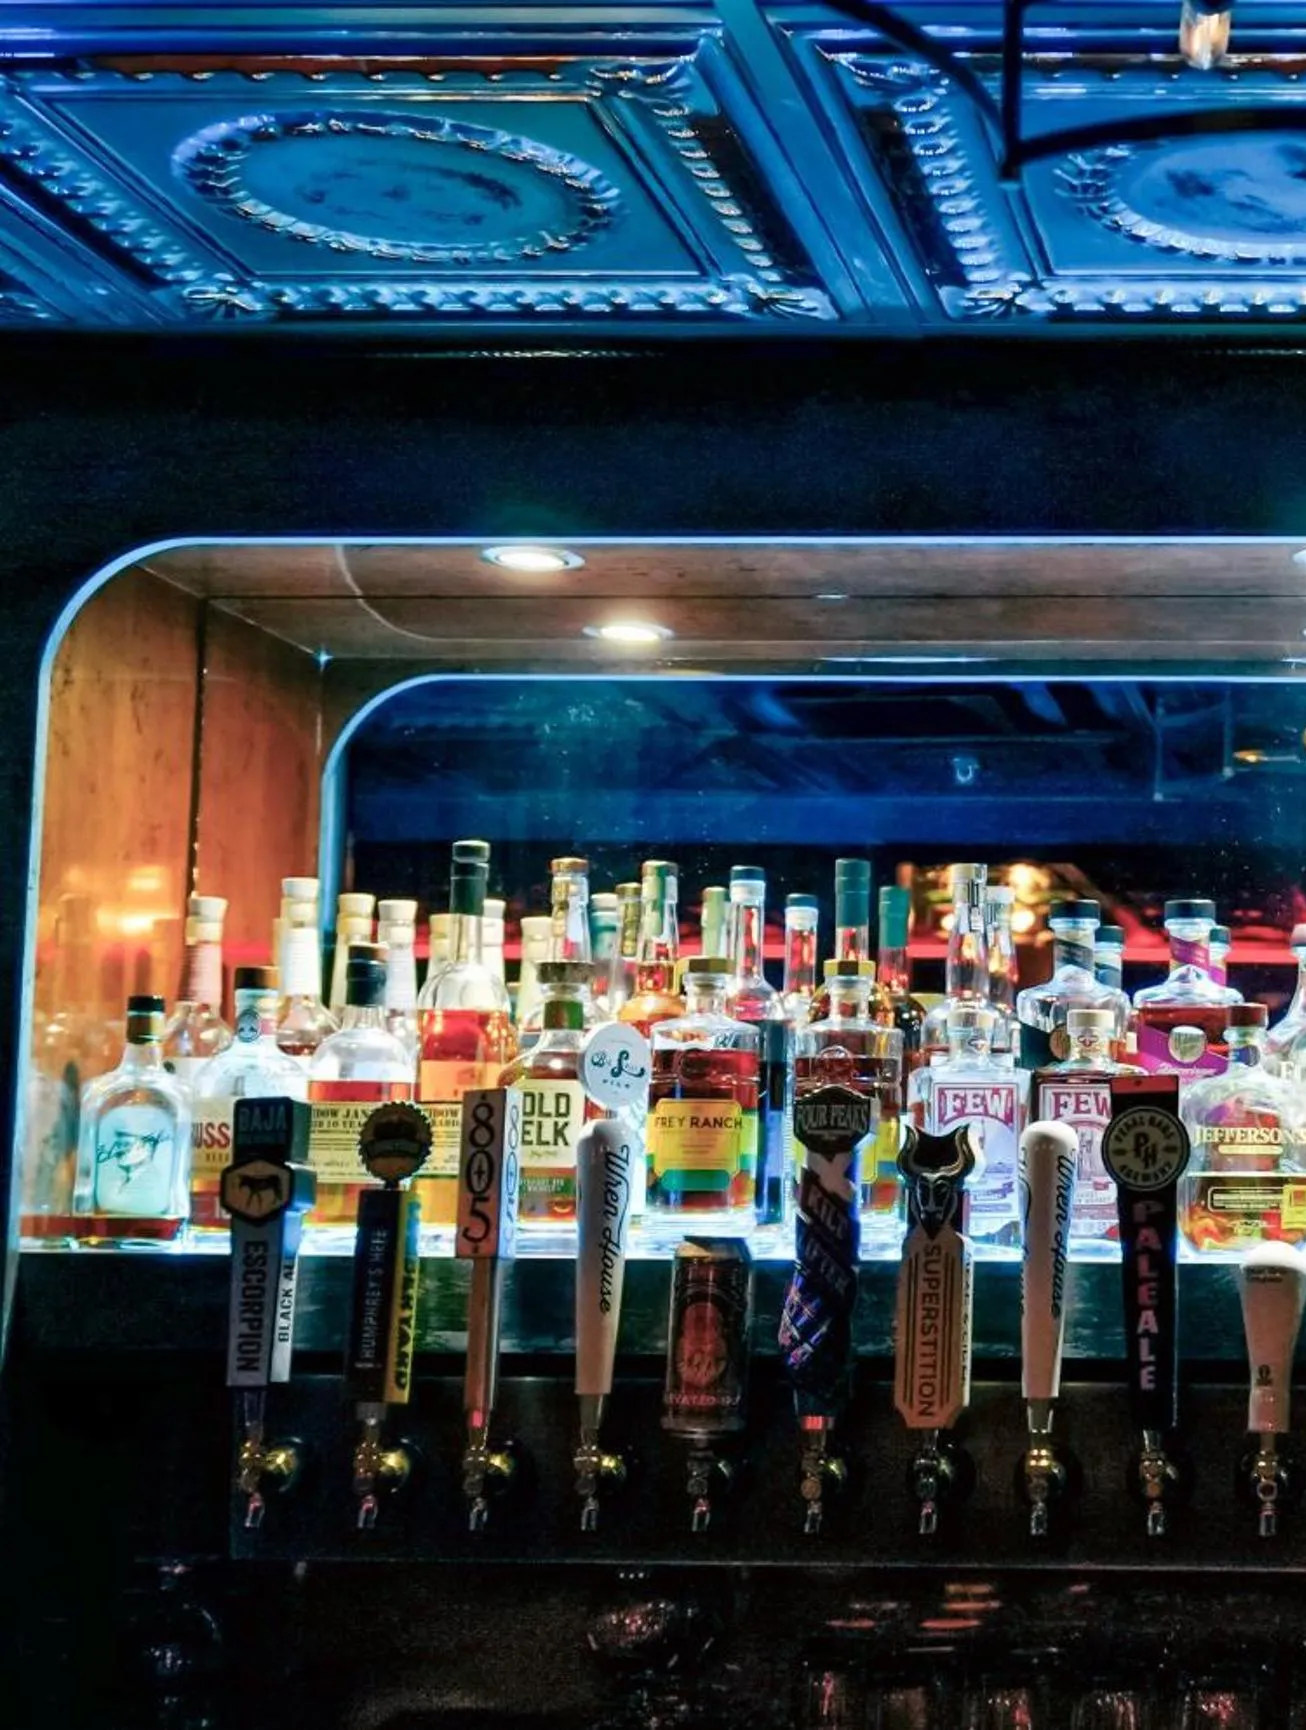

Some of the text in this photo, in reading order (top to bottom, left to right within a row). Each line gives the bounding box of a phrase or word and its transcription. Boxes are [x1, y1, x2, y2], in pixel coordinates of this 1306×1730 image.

[238, 1105, 288, 1131] BAJA
[522, 1091, 570, 1118] OLD
[655, 1116, 743, 1129] FREY RANCH
[944, 1088, 1009, 1120] FEW
[521, 1120, 570, 1147] ELK
[462, 1102, 496, 1243] 805
[599, 1144, 630, 1316] Wren House
[236, 1240, 268, 1373] ESCORPION
[277, 1288, 293, 1342] BLACK
[1131, 1200, 1165, 1391] PALE ALE
[918, 1244, 942, 1416] SUPERSTITION
